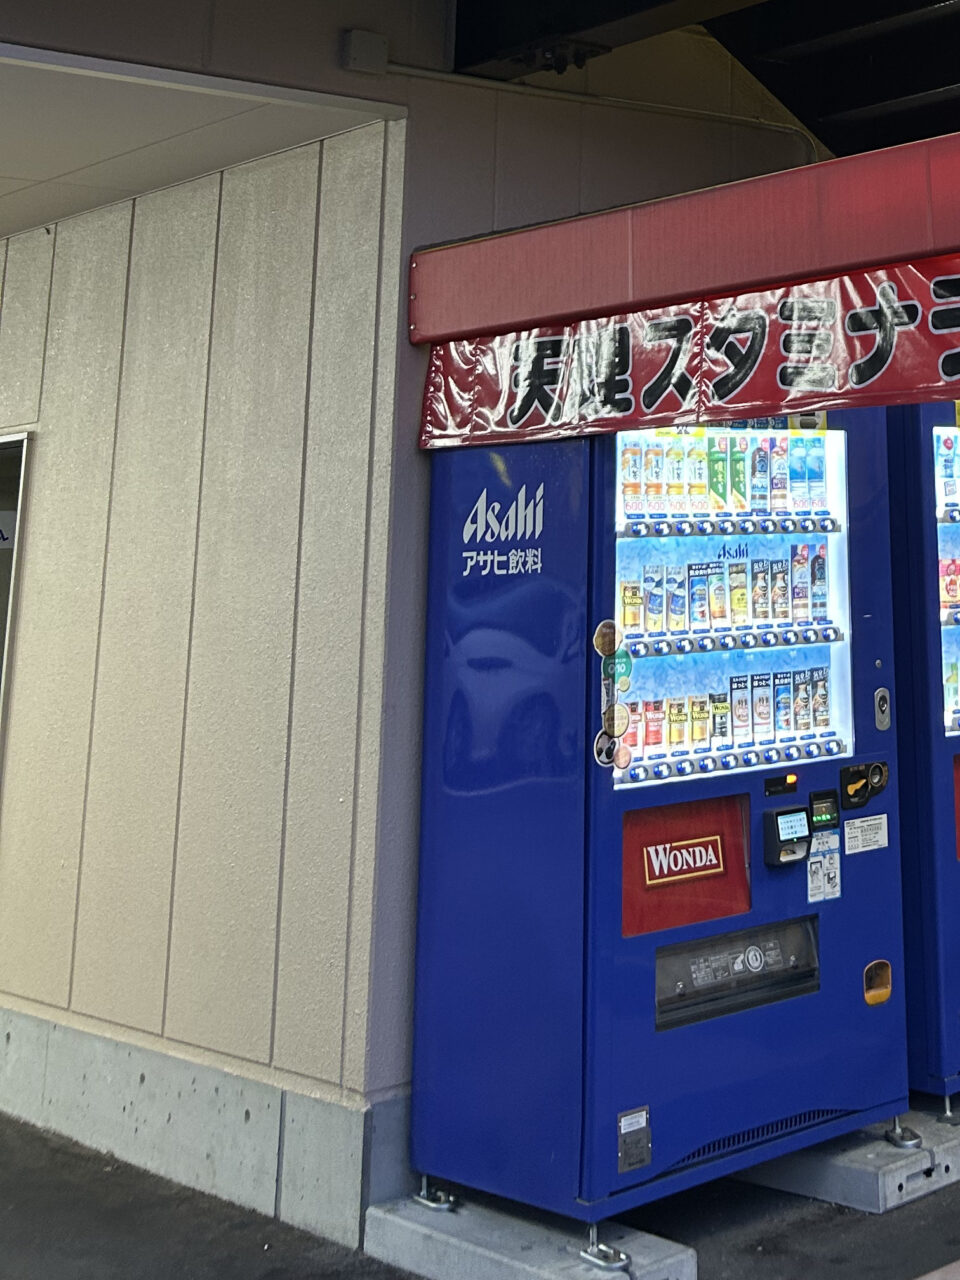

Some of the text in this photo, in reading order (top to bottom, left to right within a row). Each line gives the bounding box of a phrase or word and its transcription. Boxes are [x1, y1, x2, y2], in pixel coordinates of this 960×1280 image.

[462, 482, 544, 544] Asahi
[462, 547, 543, 577] アサヒ飲料
[718, 543, 749, 560] Asahi
[647, 843, 718, 876] WONDA
